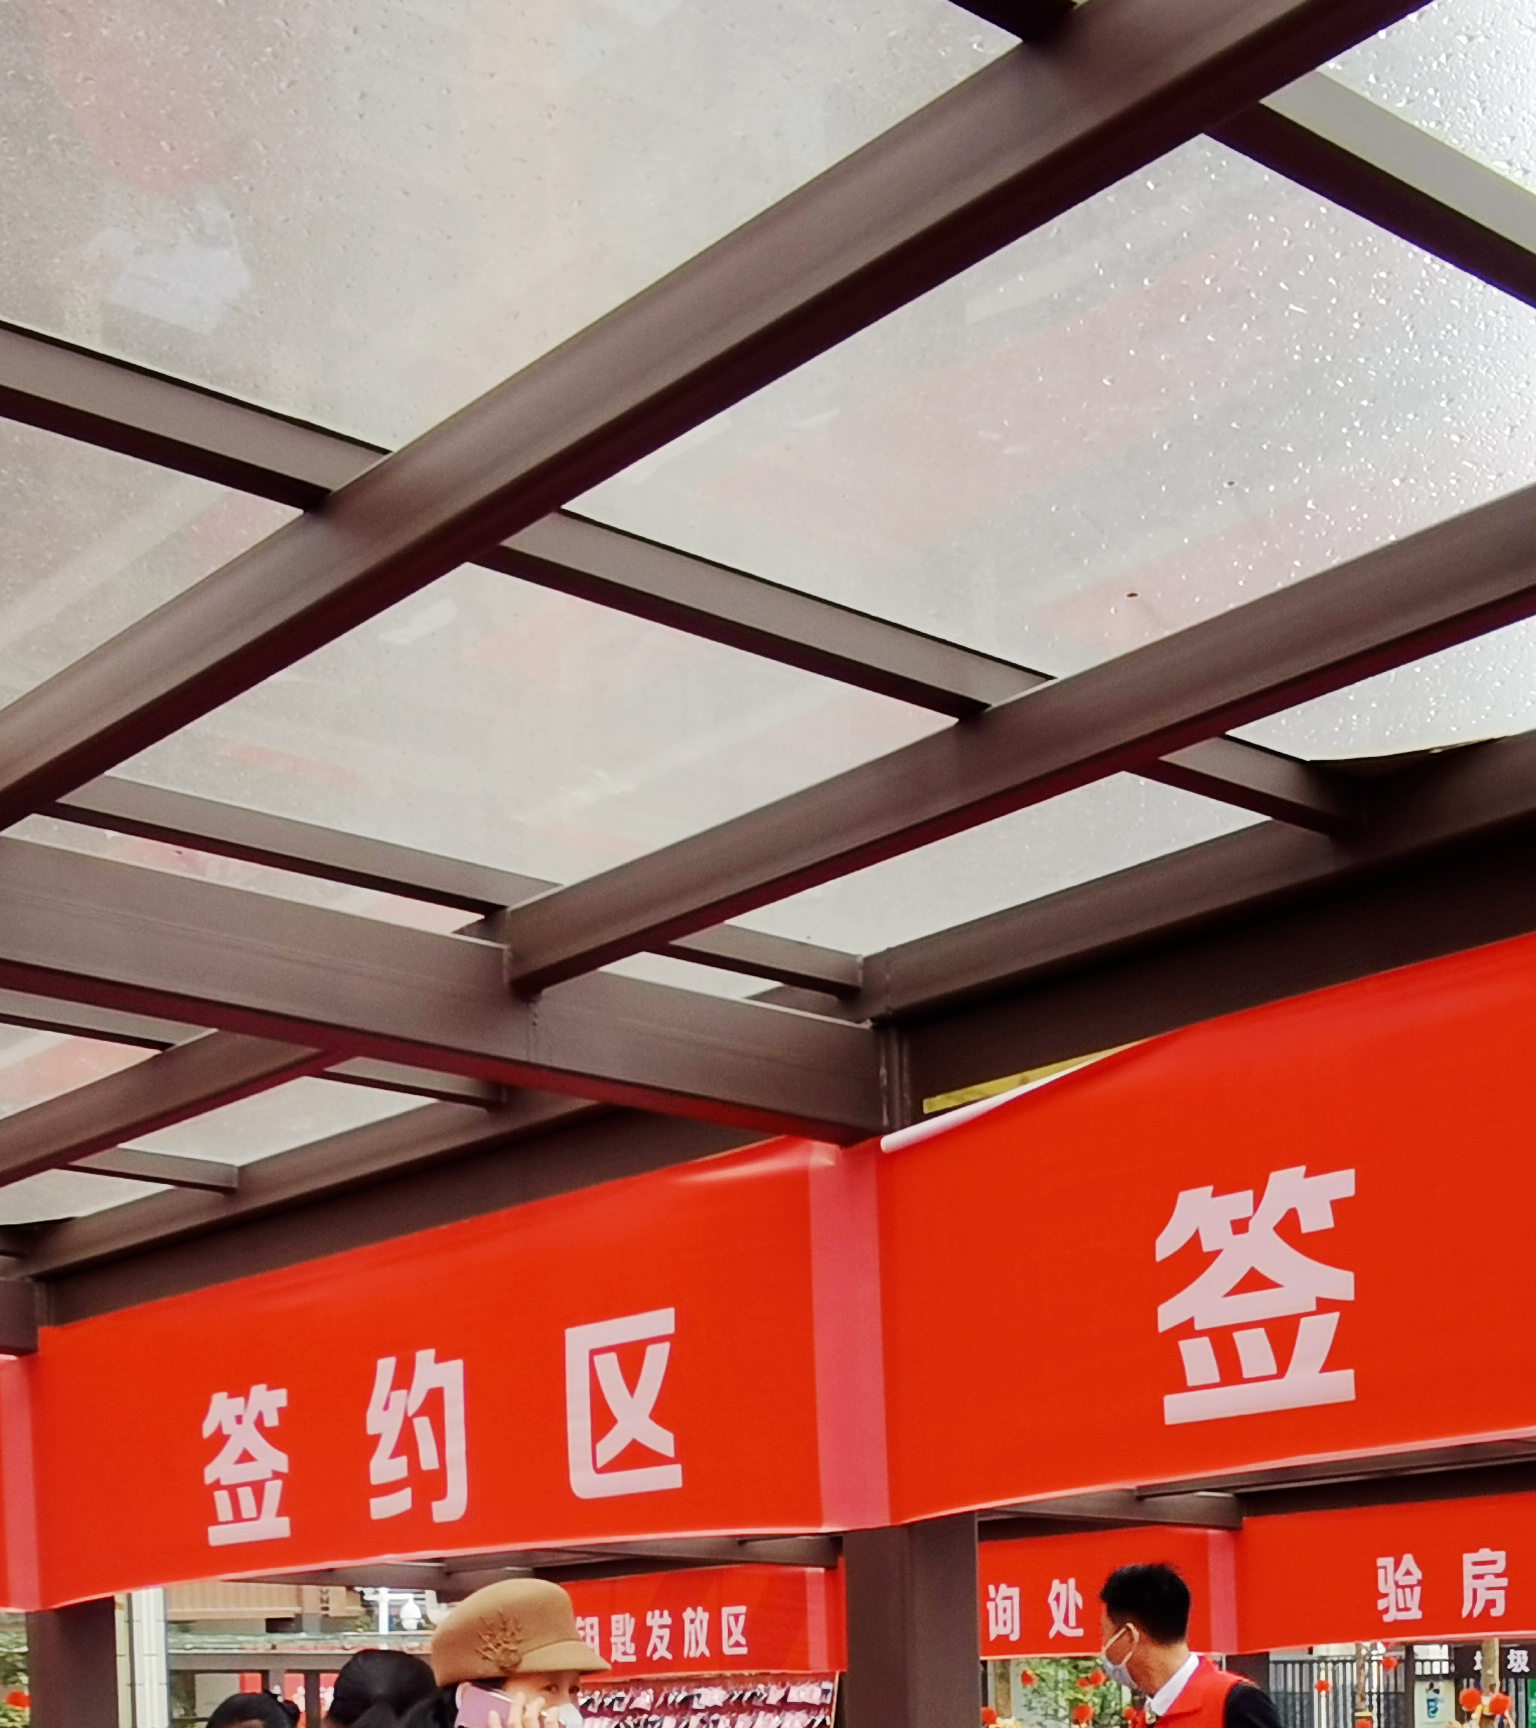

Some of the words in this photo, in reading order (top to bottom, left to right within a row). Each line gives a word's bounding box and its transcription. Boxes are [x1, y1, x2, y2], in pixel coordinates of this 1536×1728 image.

[201, 1307, 684, 1548] 签约区
[985, 1577, 1085, 1642] 询处
